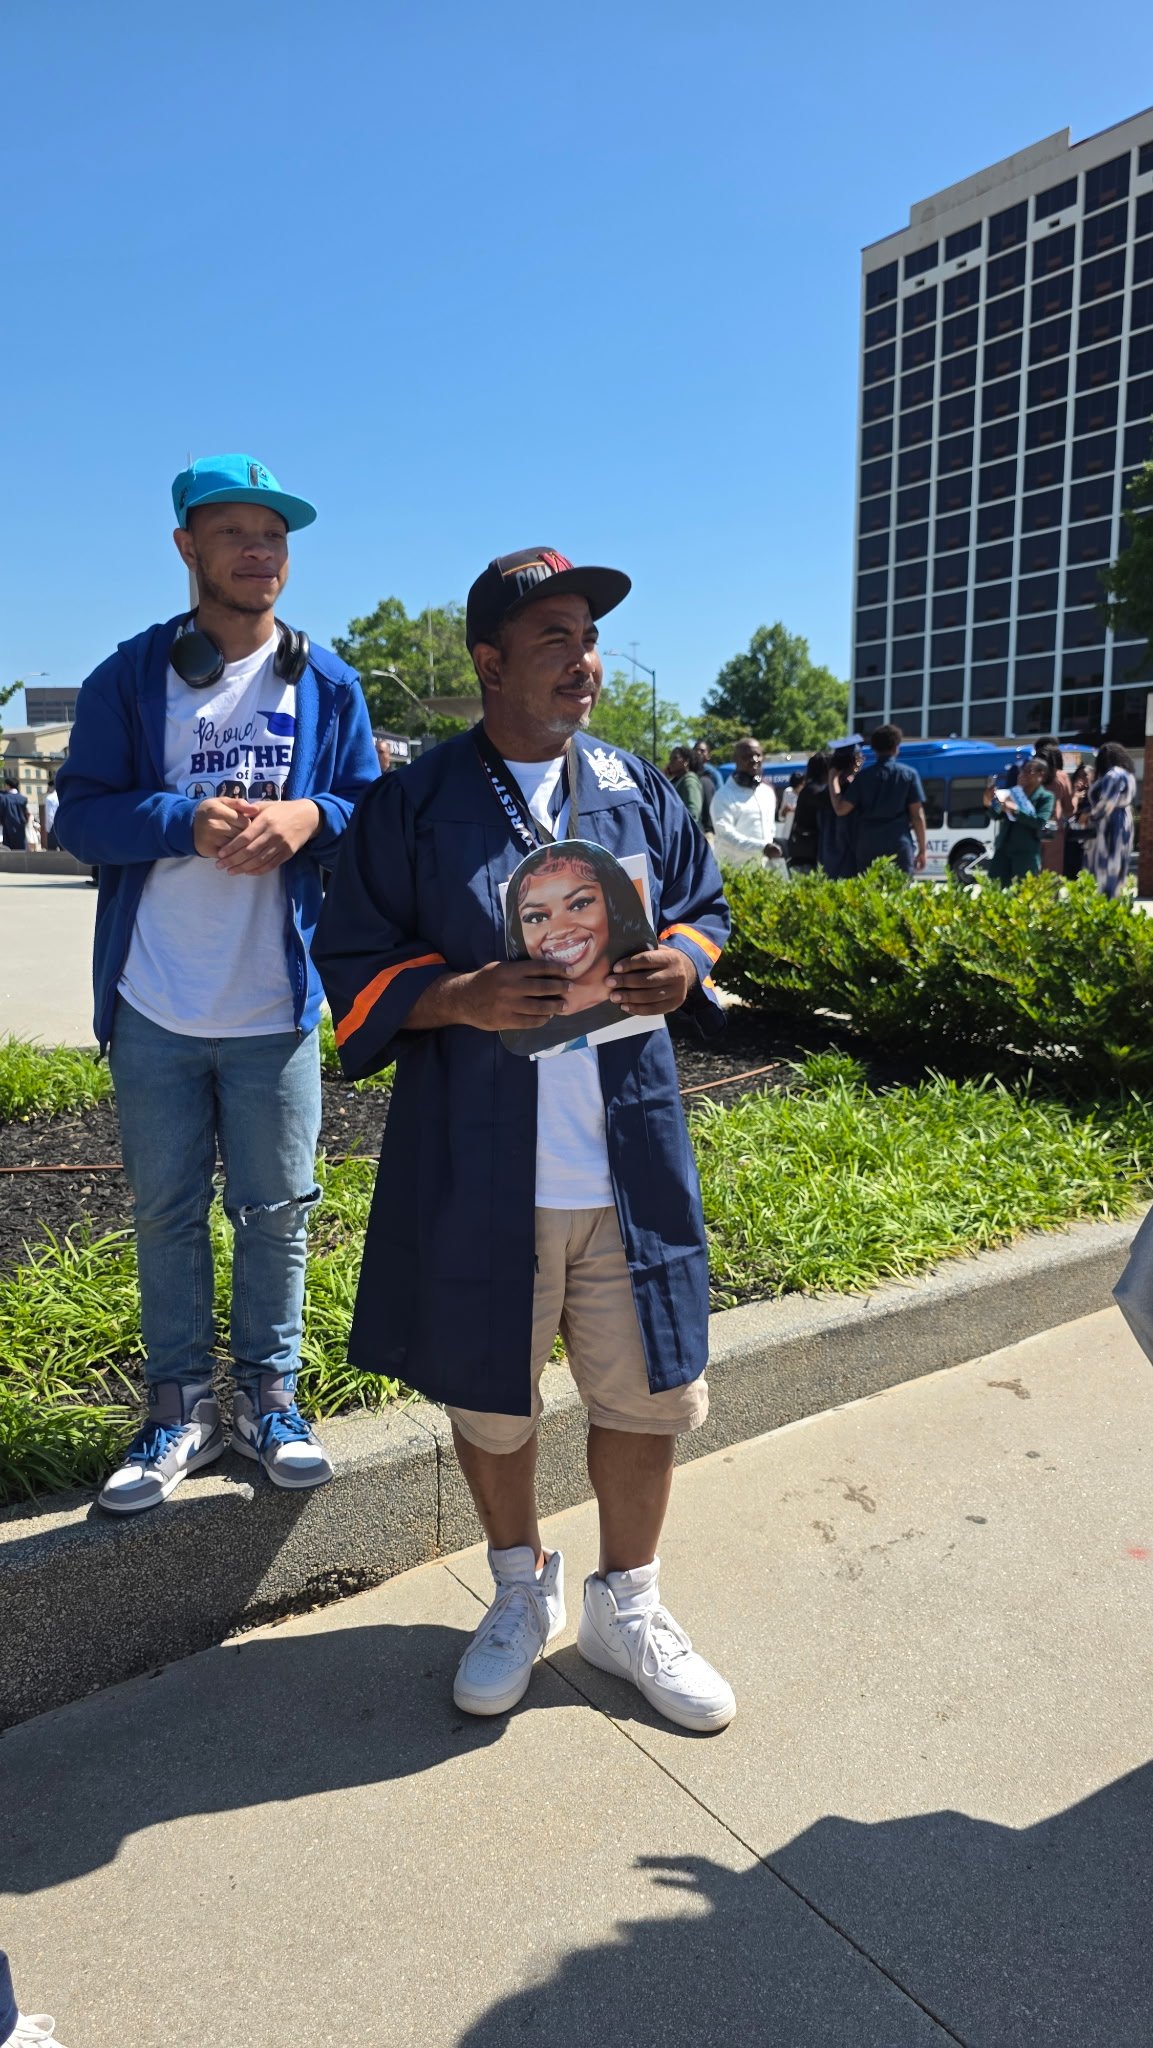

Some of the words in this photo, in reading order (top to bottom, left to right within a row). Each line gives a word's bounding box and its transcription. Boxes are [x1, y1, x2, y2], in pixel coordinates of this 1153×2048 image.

[193, 714, 257, 750] Proud
[189, 745, 291, 775] BROTHE
[236, 769, 250, 780] of
[254, 772, 265, 780] a
[484, 762, 533, 847] WREST
[926, 840, 948, 852] ATE
